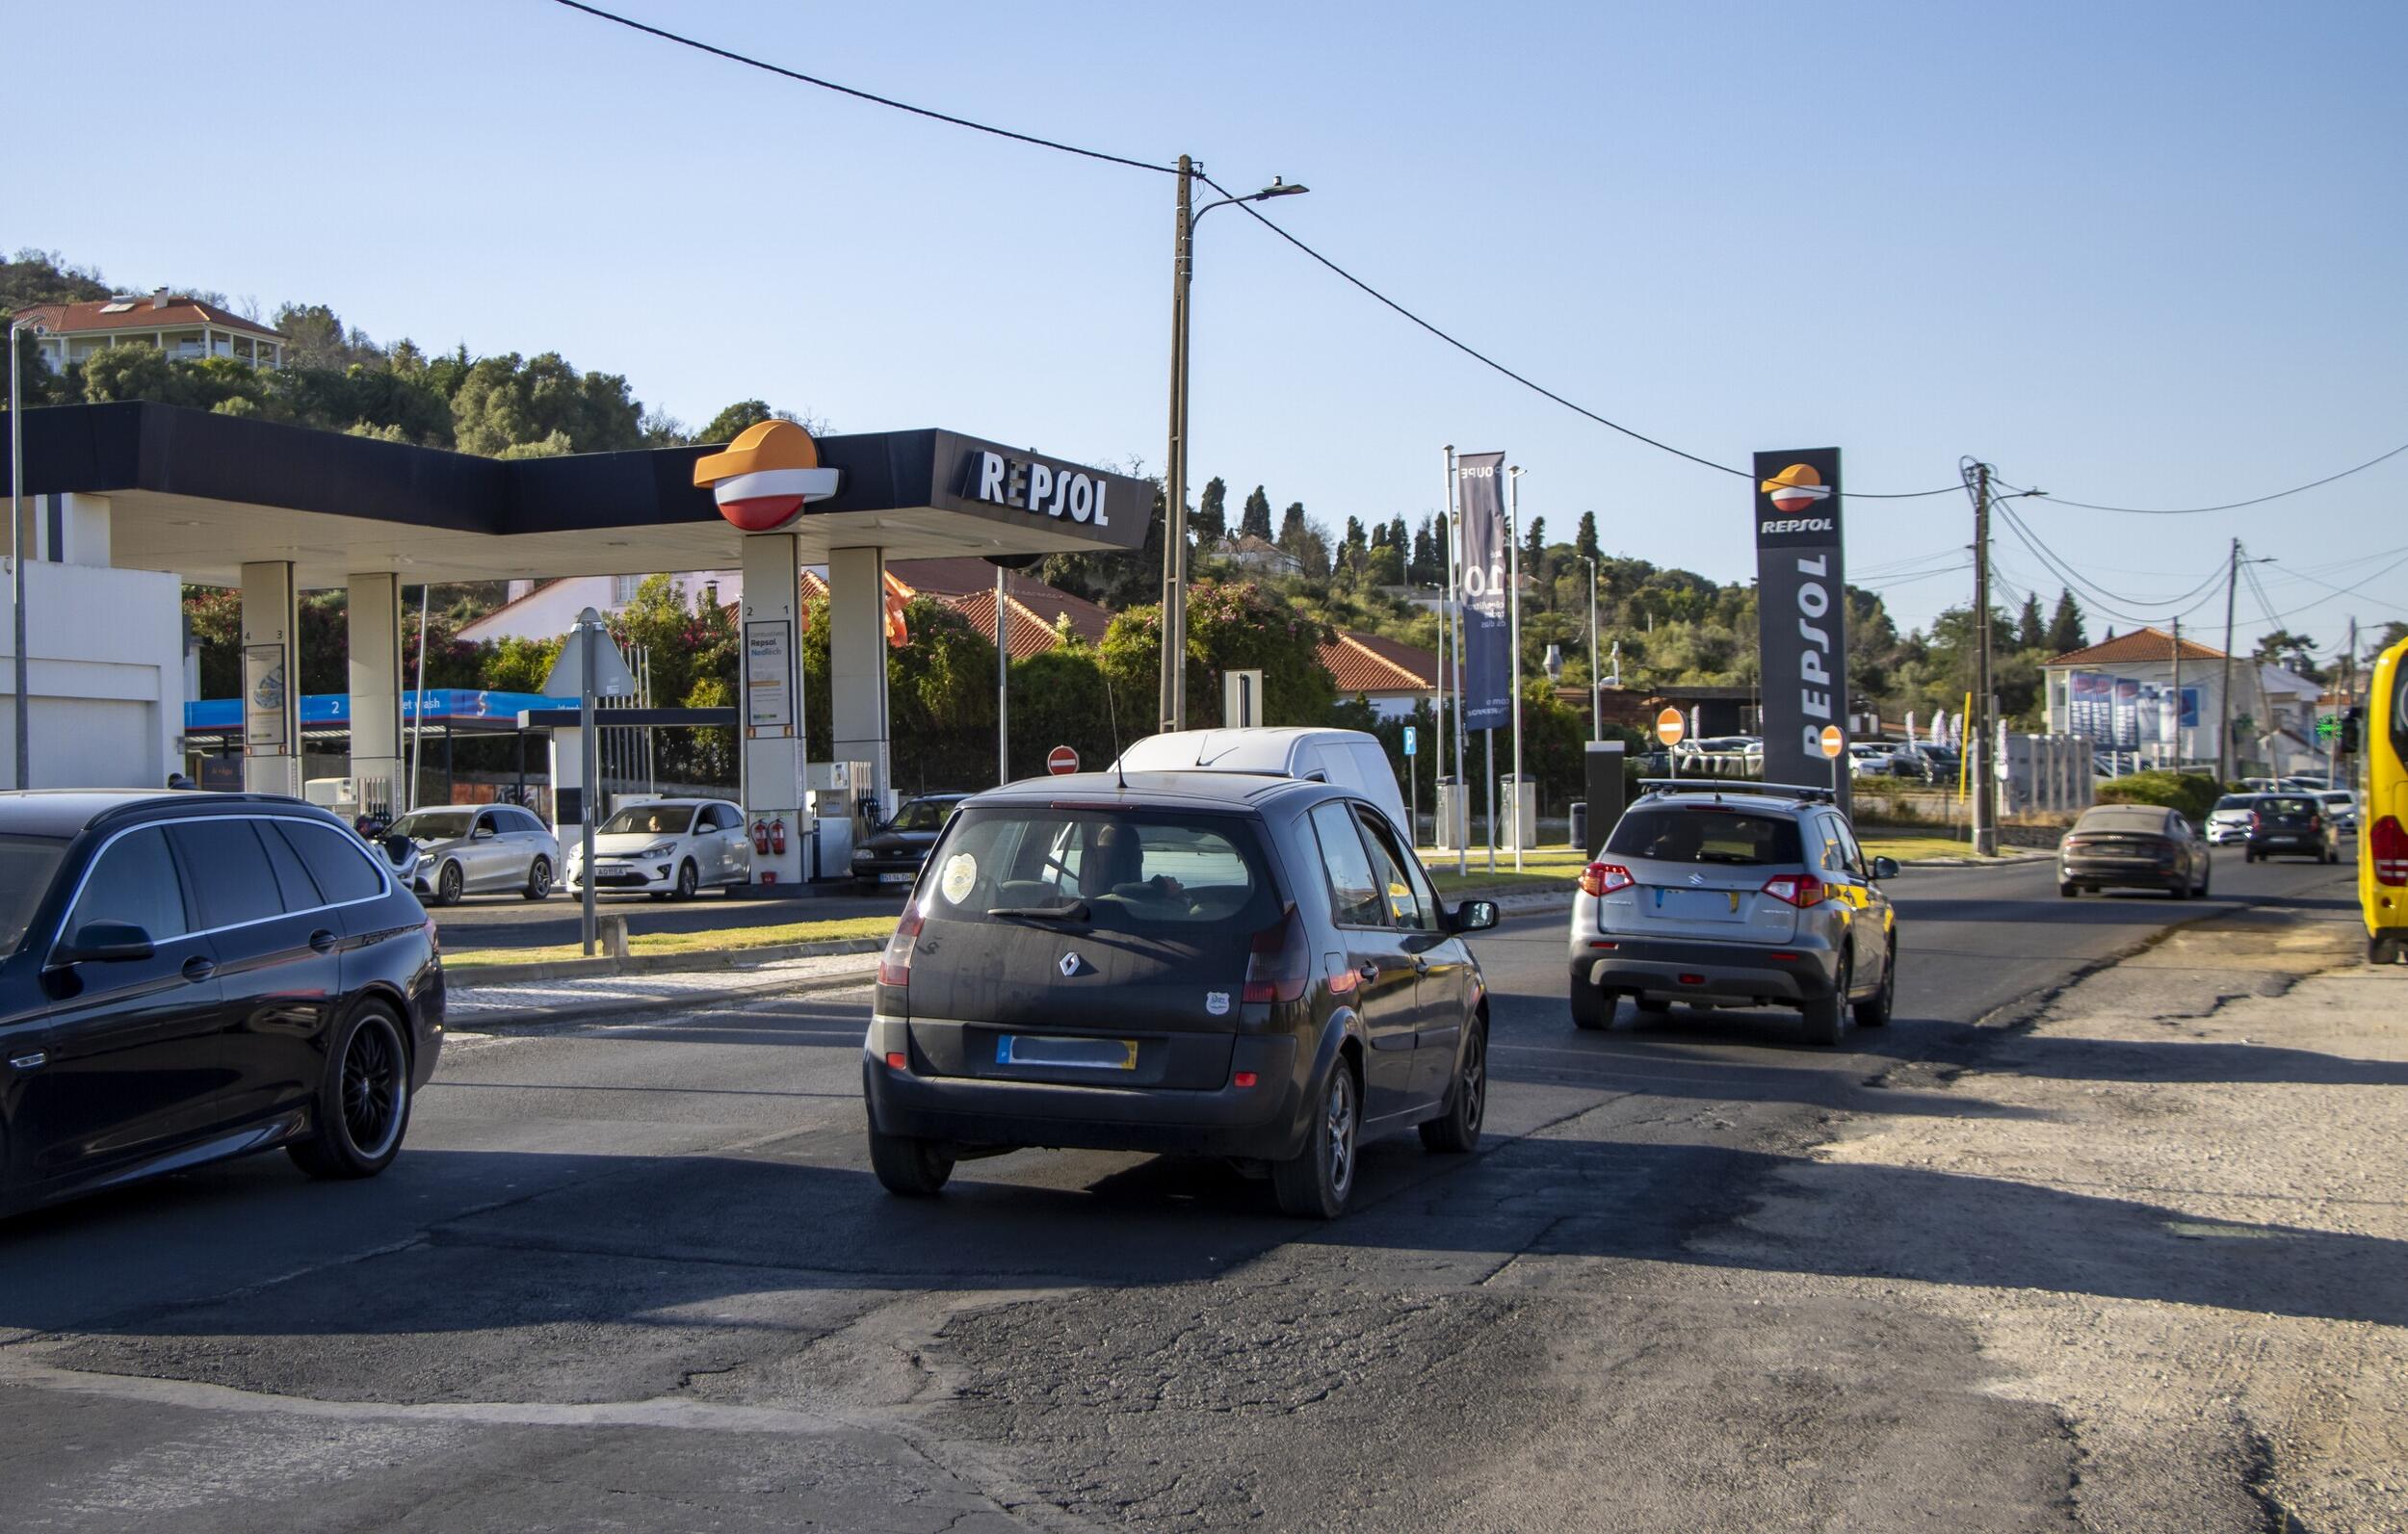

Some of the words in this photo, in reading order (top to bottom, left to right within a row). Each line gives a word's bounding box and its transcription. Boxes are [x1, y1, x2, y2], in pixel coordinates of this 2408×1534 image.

[980, 450, 1109, 527] REPSOL
[1761, 518, 1833, 533] REPSOL
[746, 607, 753, 615] 2
[783, 605, 789, 614] 1
[276, 630, 283, 638] 3
[331, 701, 339, 714] 2
[1407, 730, 1414, 751] P
